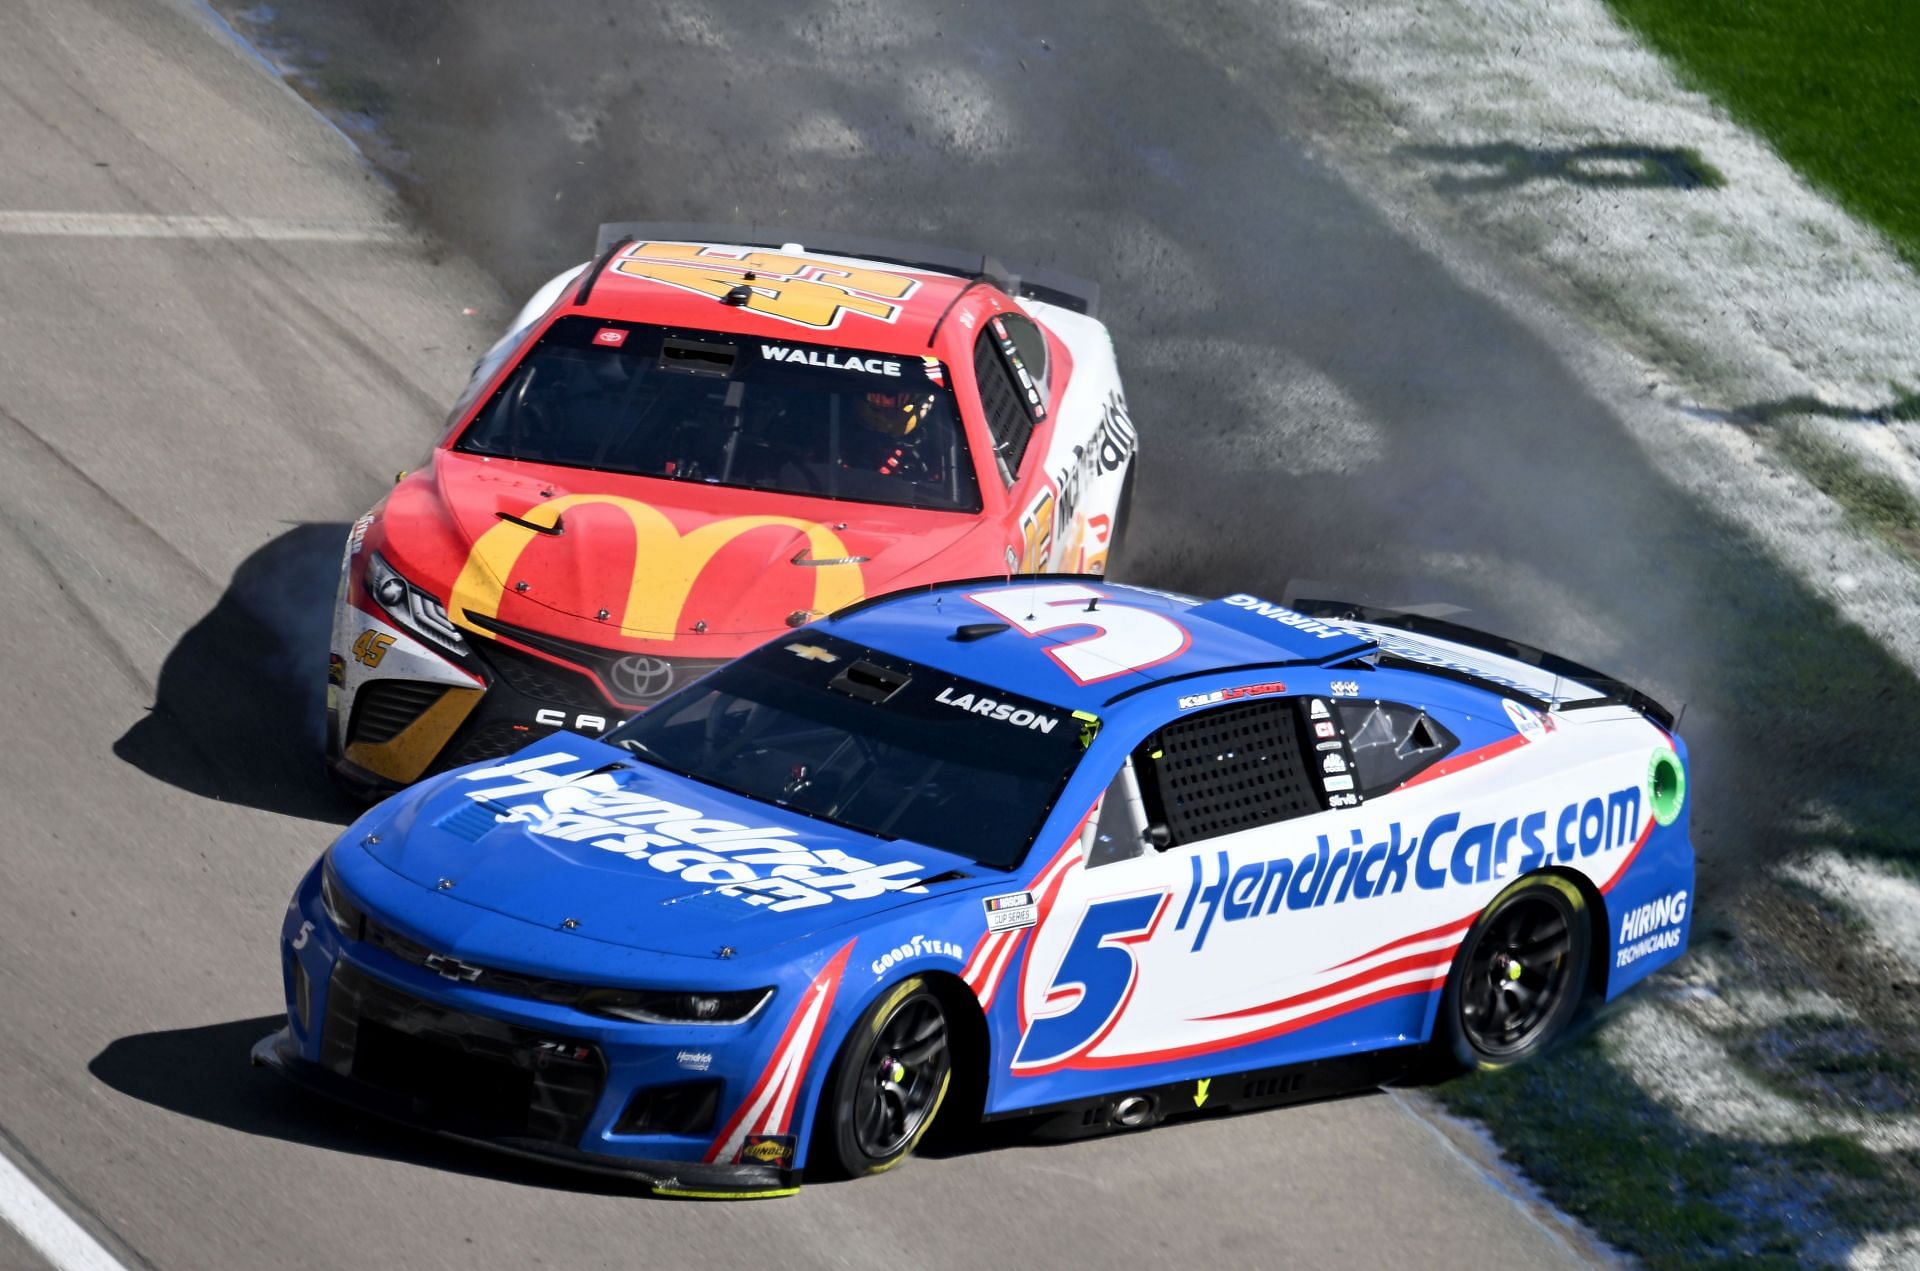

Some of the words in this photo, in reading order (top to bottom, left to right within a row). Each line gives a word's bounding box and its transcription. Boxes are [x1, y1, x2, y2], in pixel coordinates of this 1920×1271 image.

[760, 344, 902, 377] WALLACE
[968, 584, 1193, 687] 5
[1222, 593, 1344, 639] HIRING
[352, 628, 398, 669] 45
[934, 687, 1059, 734] LARSON
[457, 752, 929, 900] Hendrick
[1174, 784, 1642, 953] HendrickCars.com
[292, 920, 316, 951] 5
[994, 912, 1008, 924] CUP
[1008, 910, 1030, 921] SERIES
[1619, 889, 1688, 945] HIRING
[871, 934, 963, 976] GOODYEAR
[1616, 927, 1681, 968] TECHNICIANS
[1010, 885, 1174, 1078] 5
